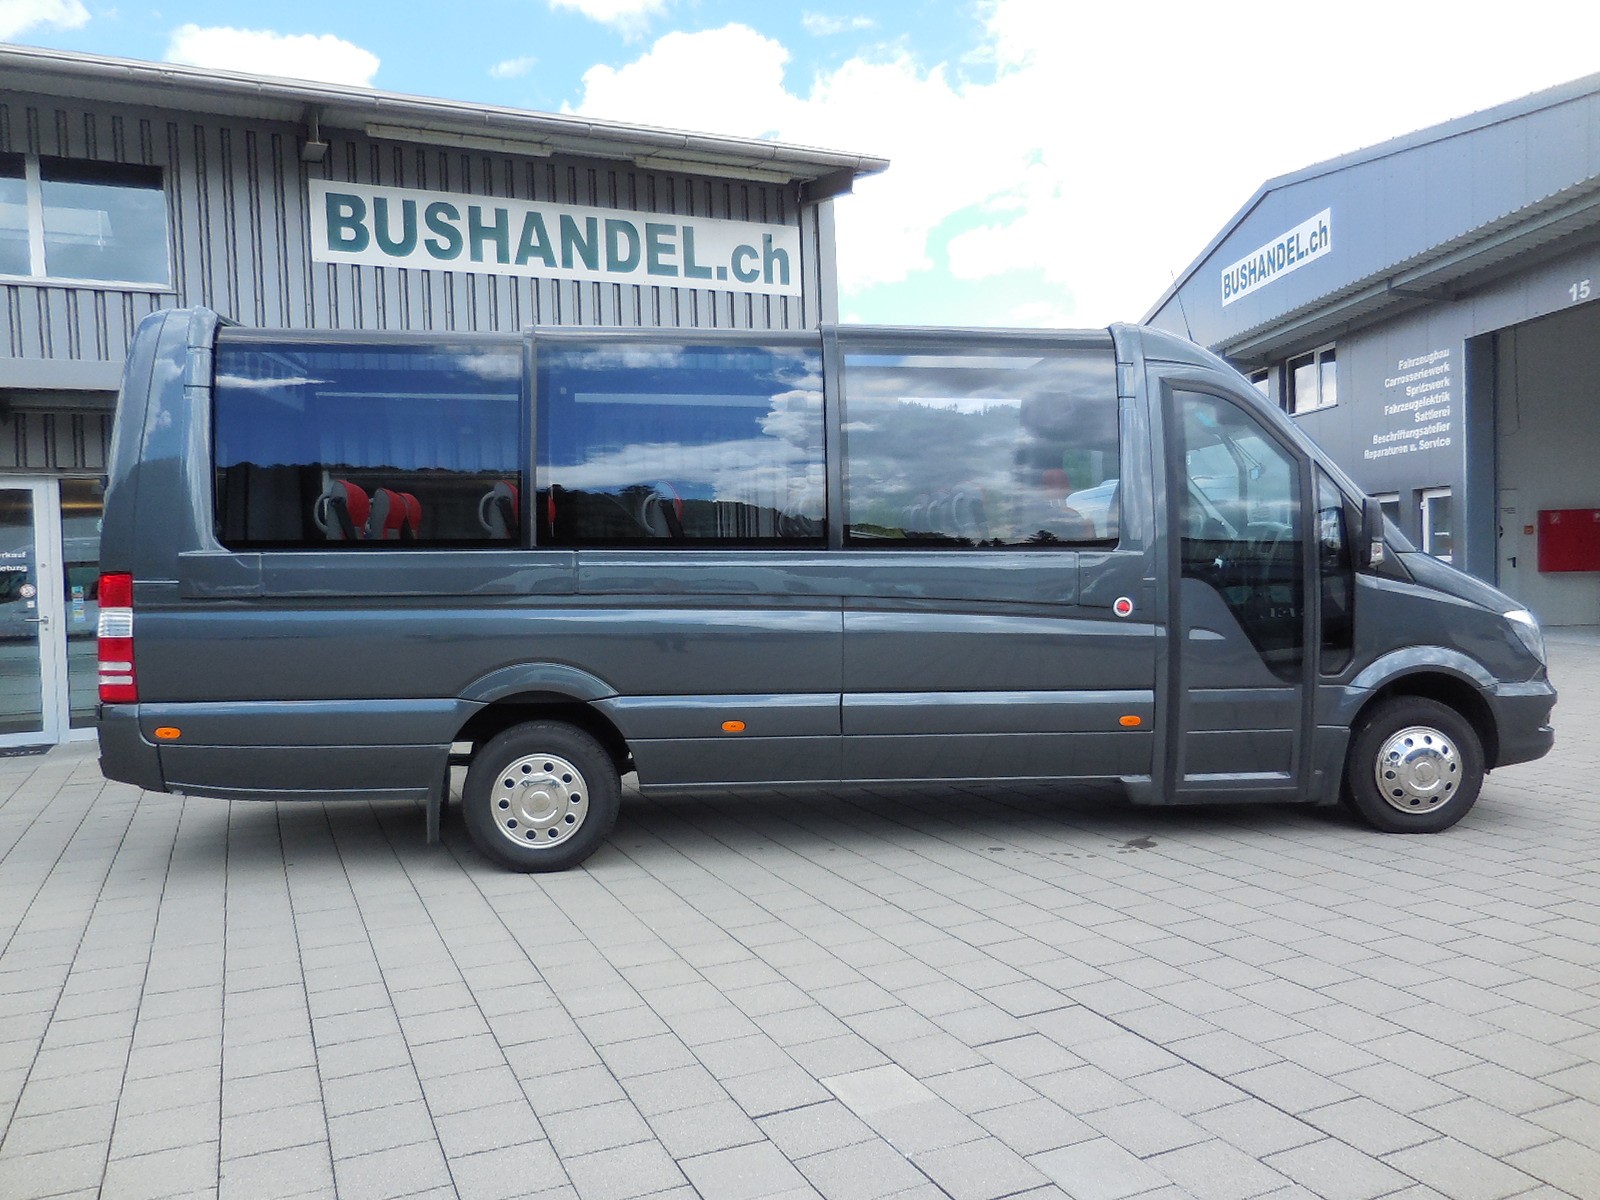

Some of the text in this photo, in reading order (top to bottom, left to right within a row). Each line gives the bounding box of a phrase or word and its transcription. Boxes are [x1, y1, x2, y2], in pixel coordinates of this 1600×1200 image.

[325, 192, 791, 286] BUSHANDEL.ch
[1223, 220, 1328, 300] BUSHANDEL.ch
[1569, 279, 1591, 302] 15
[1398, 348, 1450, 371] Fahrzeugbau
[1384, 362, 1451, 388] Carrosseriewerk
[1405, 377, 1451, 397] Spritzwerk
[1384, 391, 1451, 415] Fahrzeugelektrik
[1414, 406, 1451, 422] Sattlerei
[1372, 422, 1451, 444] Beschriftungsatelier
[1364, 444, 1408, 460] Reparaturen
[1419, 437, 1451, 450] Service
